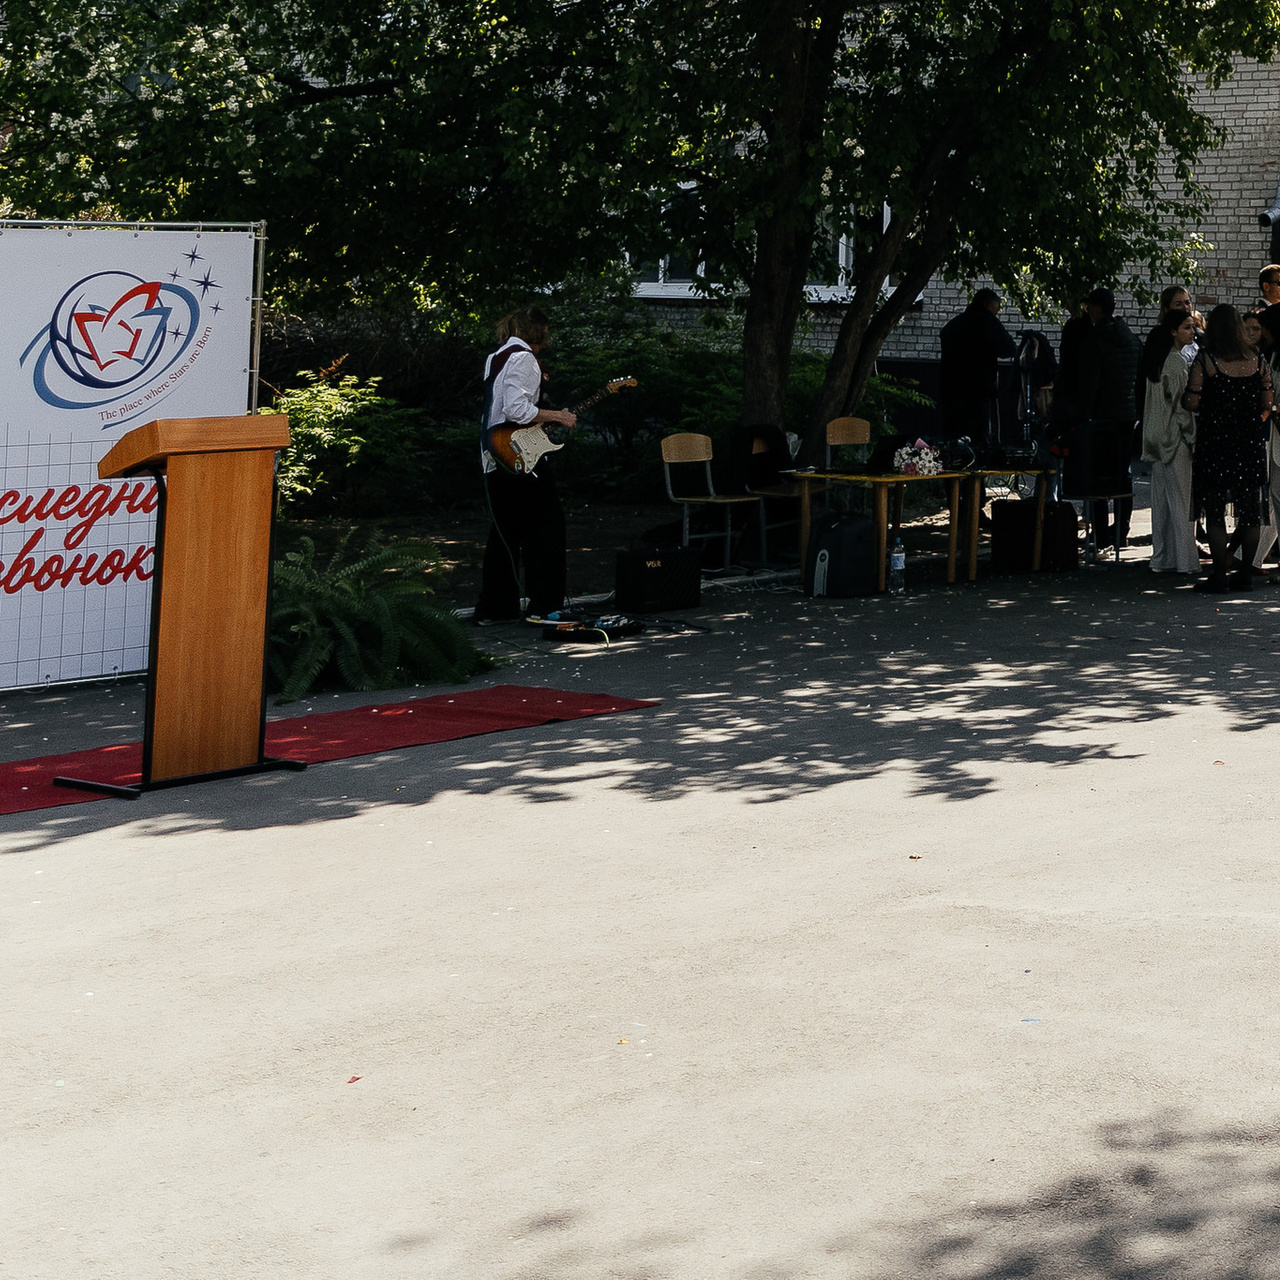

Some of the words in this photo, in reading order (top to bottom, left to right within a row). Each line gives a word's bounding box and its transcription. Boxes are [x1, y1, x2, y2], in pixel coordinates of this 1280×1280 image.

[98, 409, 118, 421] The
[119, 398, 144, 417] place
[144, 381, 170, 401] where
[168, 362, 190, 384] Stars
[189, 349, 201, 364] are
[196, 326, 213, 350] Born
[0, 527, 155, 594] вонок
